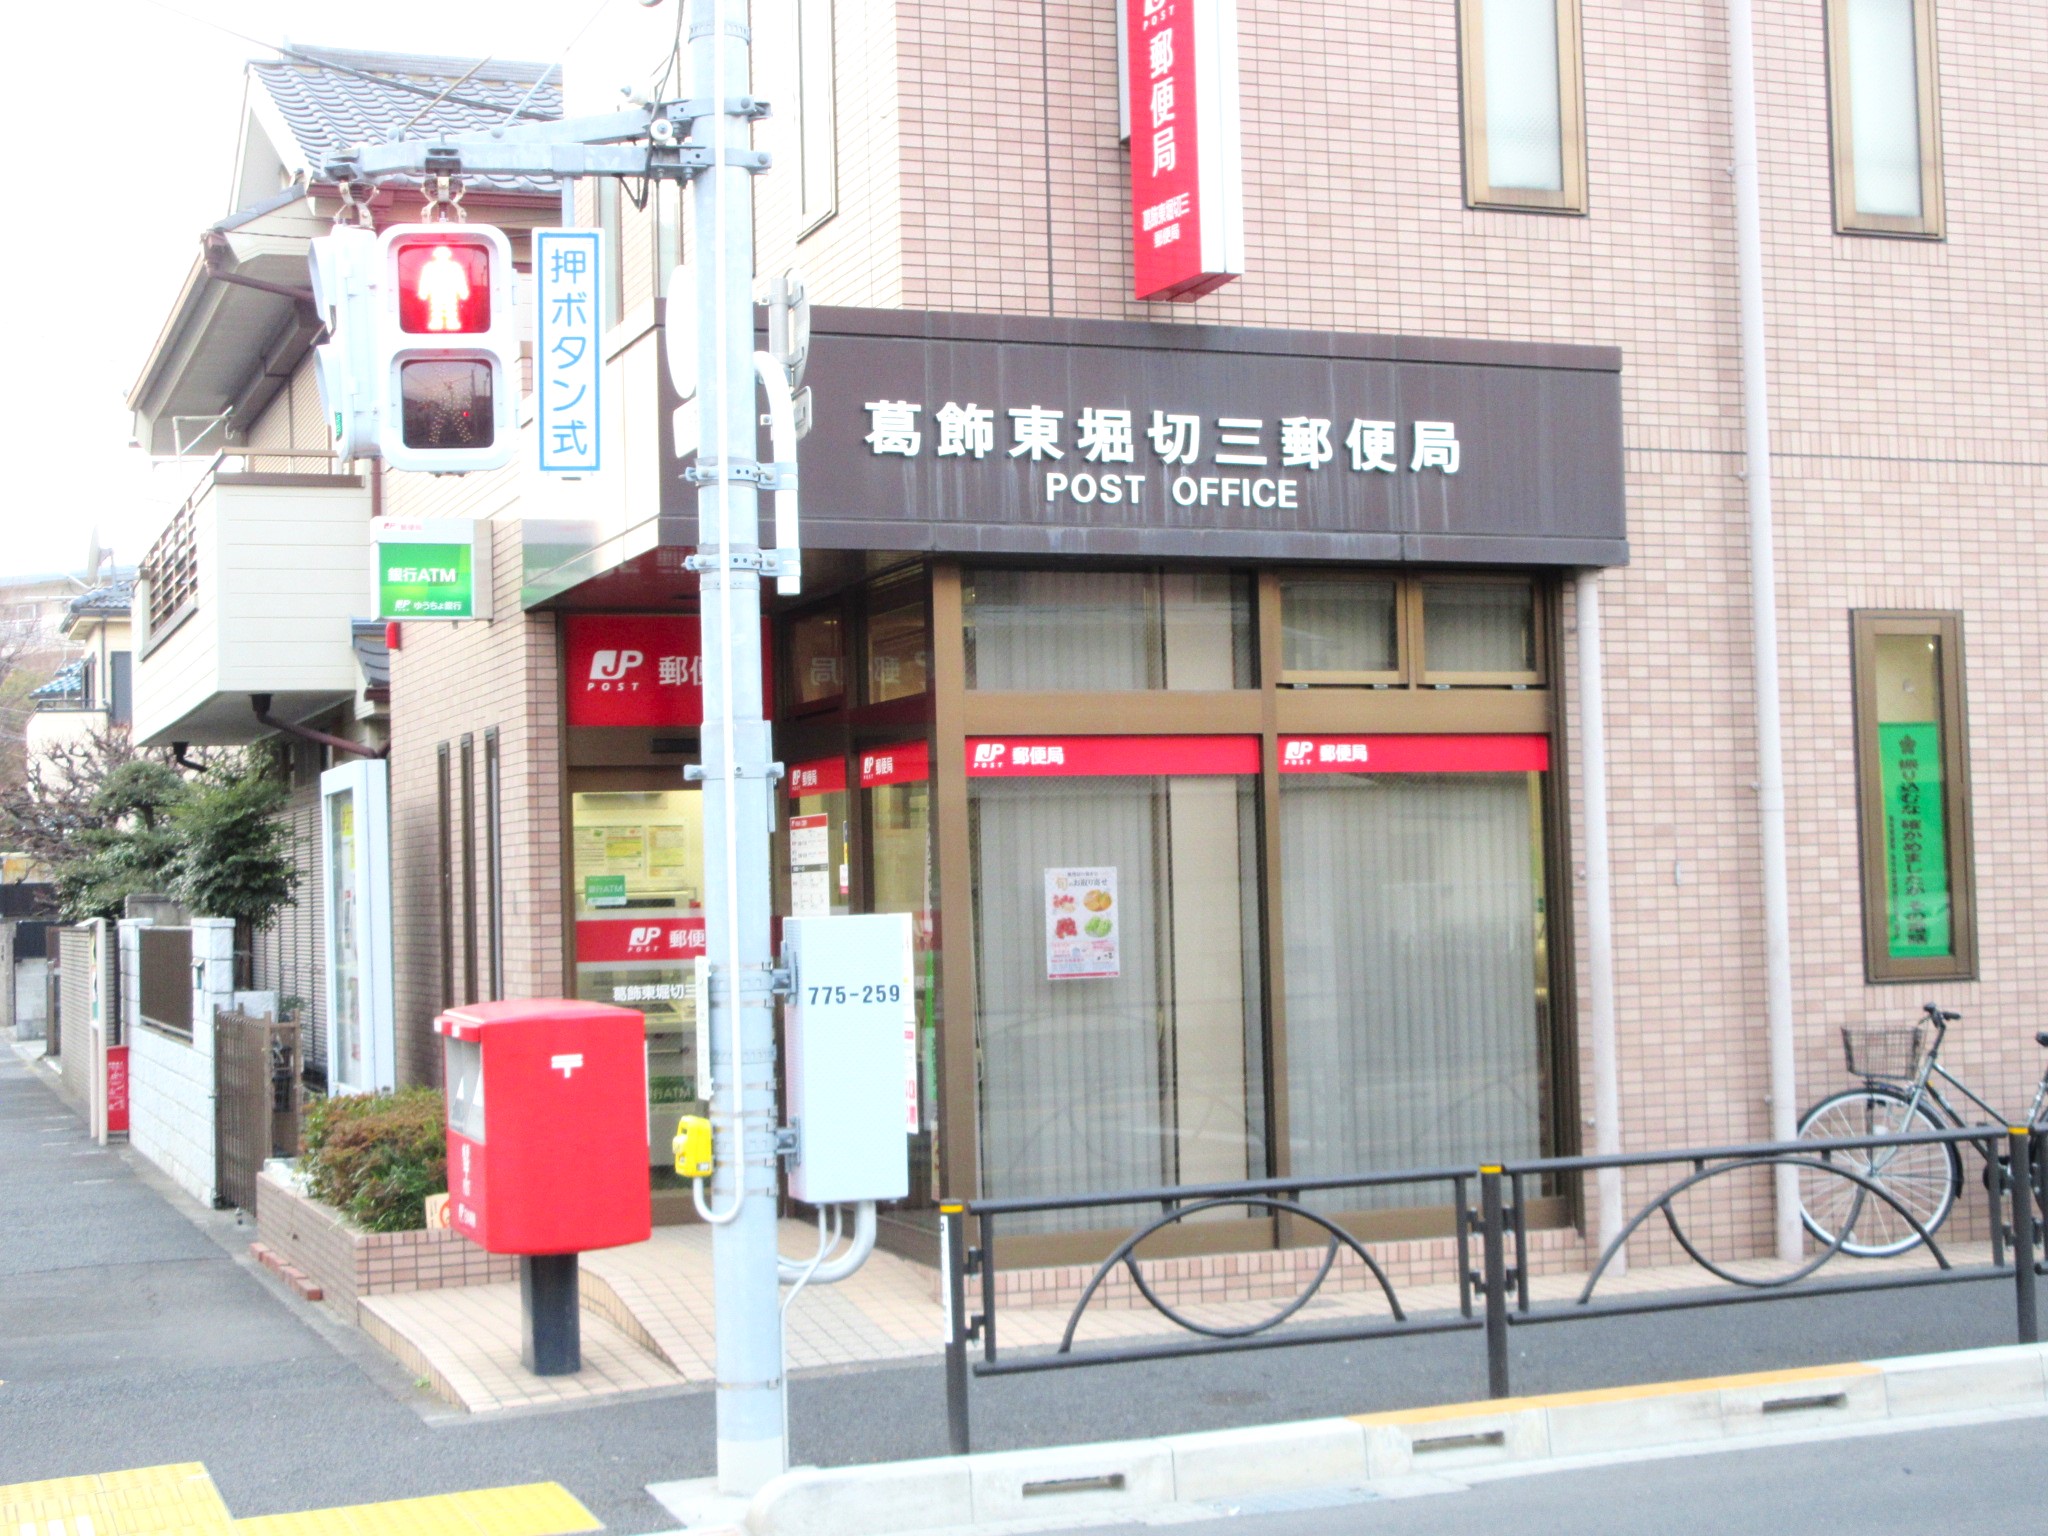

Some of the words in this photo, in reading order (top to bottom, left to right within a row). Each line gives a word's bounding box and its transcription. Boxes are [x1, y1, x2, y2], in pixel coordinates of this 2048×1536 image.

[1143, 5, 1175, 31] POST
[1150, 28, 1176, 177] 郵便局
[551, 248, 587, 456] 押ボタン式
[864, 399, 1460, 474] 葛飾東堀切三郵便局
[1046, 472, 1145, 504] POST
[1172, 475, 1298, 508] OFFICE
[387, 567, 457, 583] 銀行ATM
[587, 682, 640, 691] POST
[1012, 746, 1065, 765] 郵便局
[1319, 743, 1368, 763] 郵便局
[808, 984, 900, 1005] 775-259
